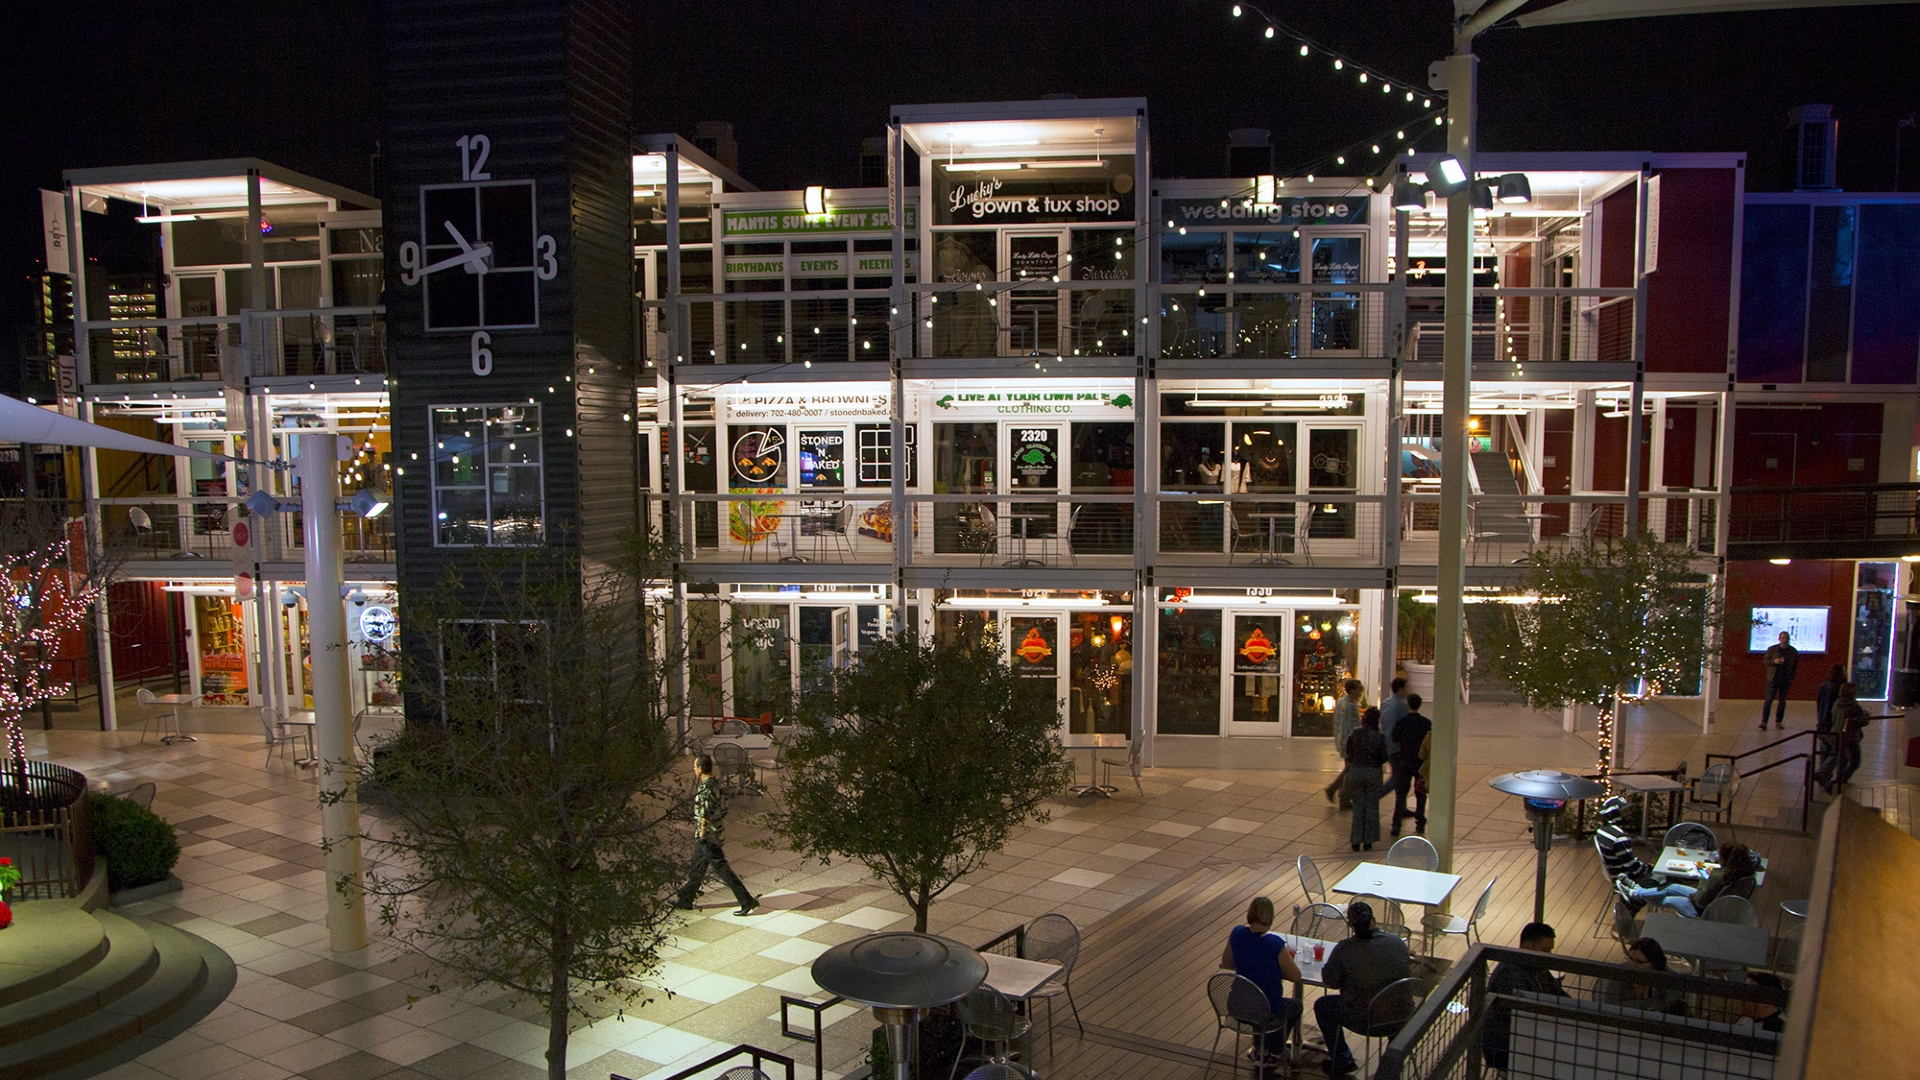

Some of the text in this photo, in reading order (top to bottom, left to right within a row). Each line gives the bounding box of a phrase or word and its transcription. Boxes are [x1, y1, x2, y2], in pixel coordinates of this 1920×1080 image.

[456, 134, 491, 181] 12
[949, 177, 1003, 212] Lucky's
[972, 196, 1120, 218] gown & tux shop
[1180, 200, 1349, 223] wedding store
[727, 212, 914, 231] MANTIS SUITE EVENT SPE
[399, 241, 421, 286] 9
[537, 234, 558, 280] 3
[859, 258, 911, 270] MEETIS
[726, 261, 784, 274] BIRTHDAYS
[800, 260, 839, 272] EVENTS
[1080, 265, 1129, 281] Tuxedos
[471, 331, 493, 376] 6
[735, 409, 769, 418] delivery:
[771, 409, 823, 417] 702-480-0007
[830, 408, 892, 417] stonednbaked.c
[997, 405, 1073, 413] CLOTHING CO.
[800, 436, 843, 445] STONED
[1021, 430, 1048, 442] 2320
[743, 617, 780, 631] vegan
[754, 635, 775, 650] afe
